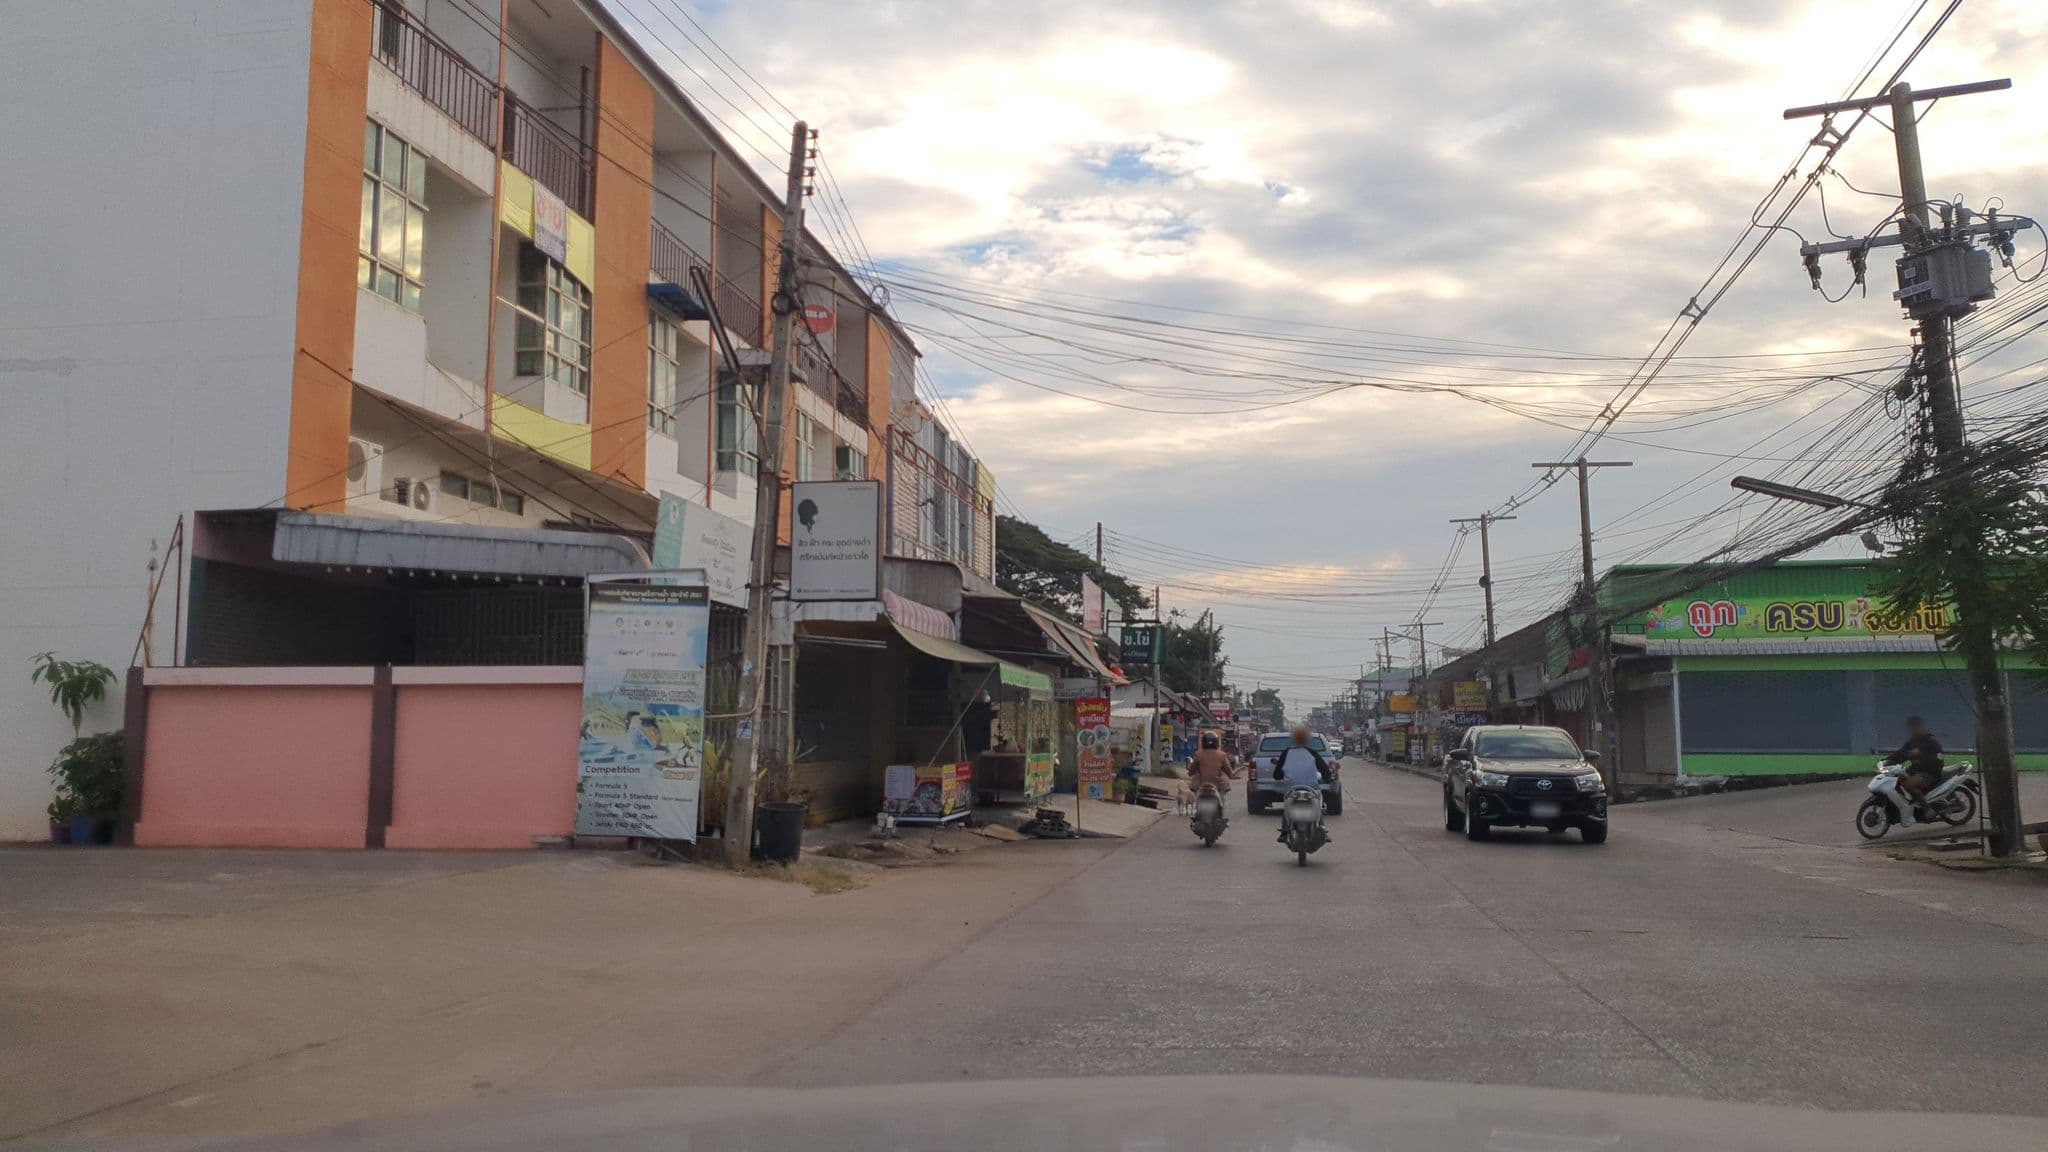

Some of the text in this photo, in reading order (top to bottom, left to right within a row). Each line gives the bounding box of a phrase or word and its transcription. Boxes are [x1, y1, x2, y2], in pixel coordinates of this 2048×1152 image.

[1688, 601, 1736, 636] ถูก
[1764, 602, 1844, 633] ครบ
[585, 765, 640, 775] Competition
